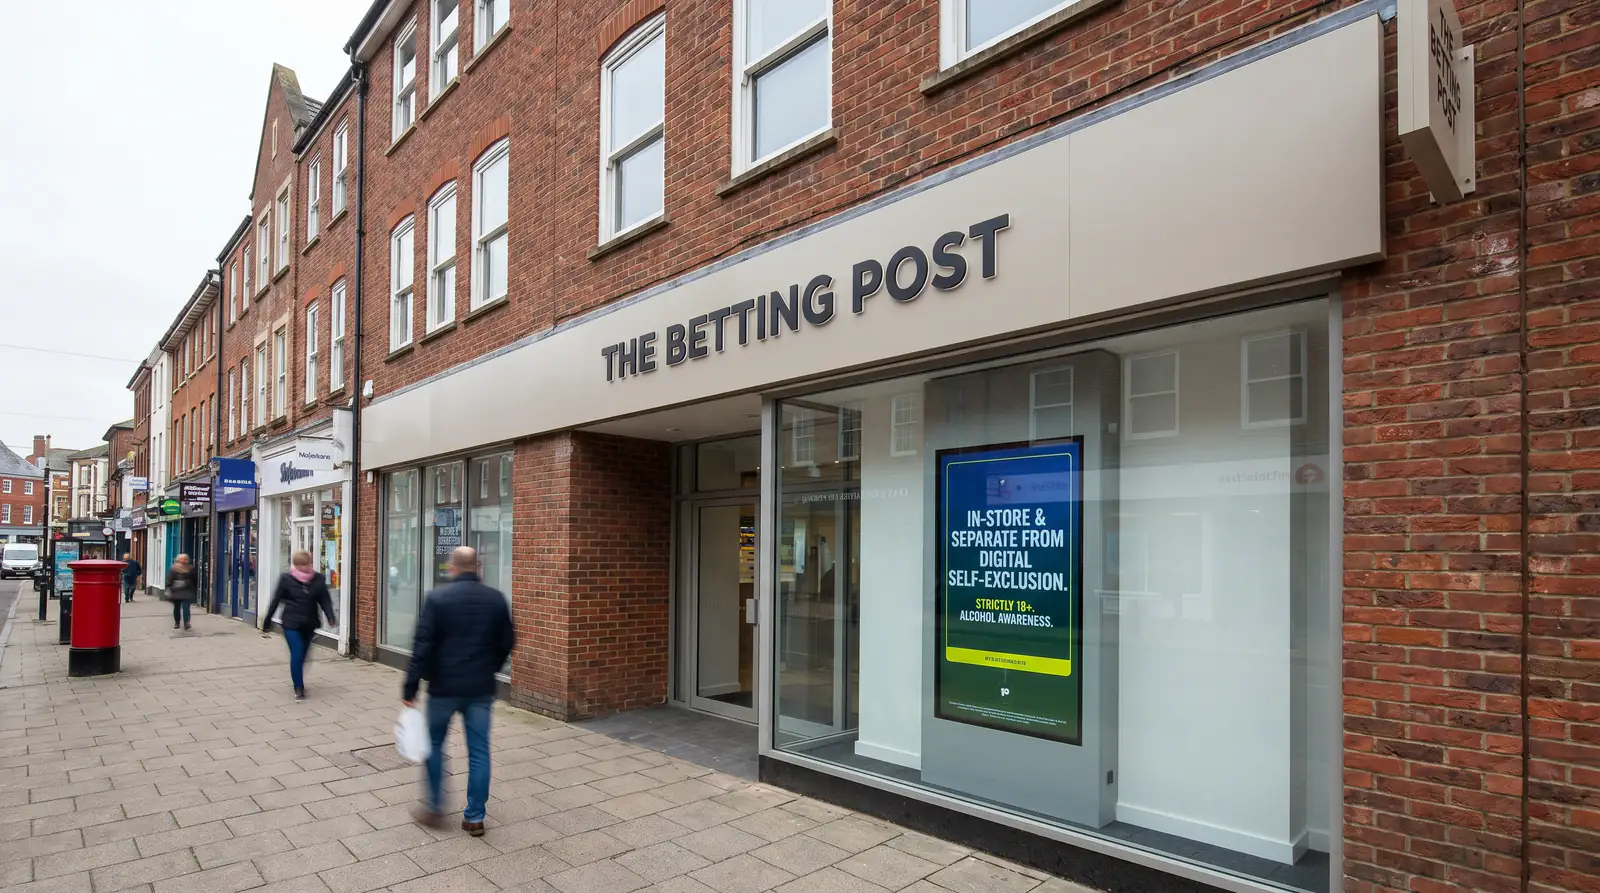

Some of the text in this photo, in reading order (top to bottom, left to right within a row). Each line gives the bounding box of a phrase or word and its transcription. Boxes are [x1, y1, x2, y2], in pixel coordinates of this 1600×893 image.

[1439, 7, 1454, 61] THE
[1430, 23, 1461, 112] BETTING
[1437, 75, 1457, 135] POST
[601, 213, 1010, 382] THE BETTING POST
[967, 507, 1046, 527] IN-STORE &
[951, 529, 1064, 547] SEPARATE FROM
[979, 550, 1033, 568] DIGITAL
[948, 569, 1068, 591] SELF-EXCLUSION.
[975, 598, 1035, 613] STRICTLY 18+.
[960, 610, 1054, 628] ALCOHOL AWARENESS.
